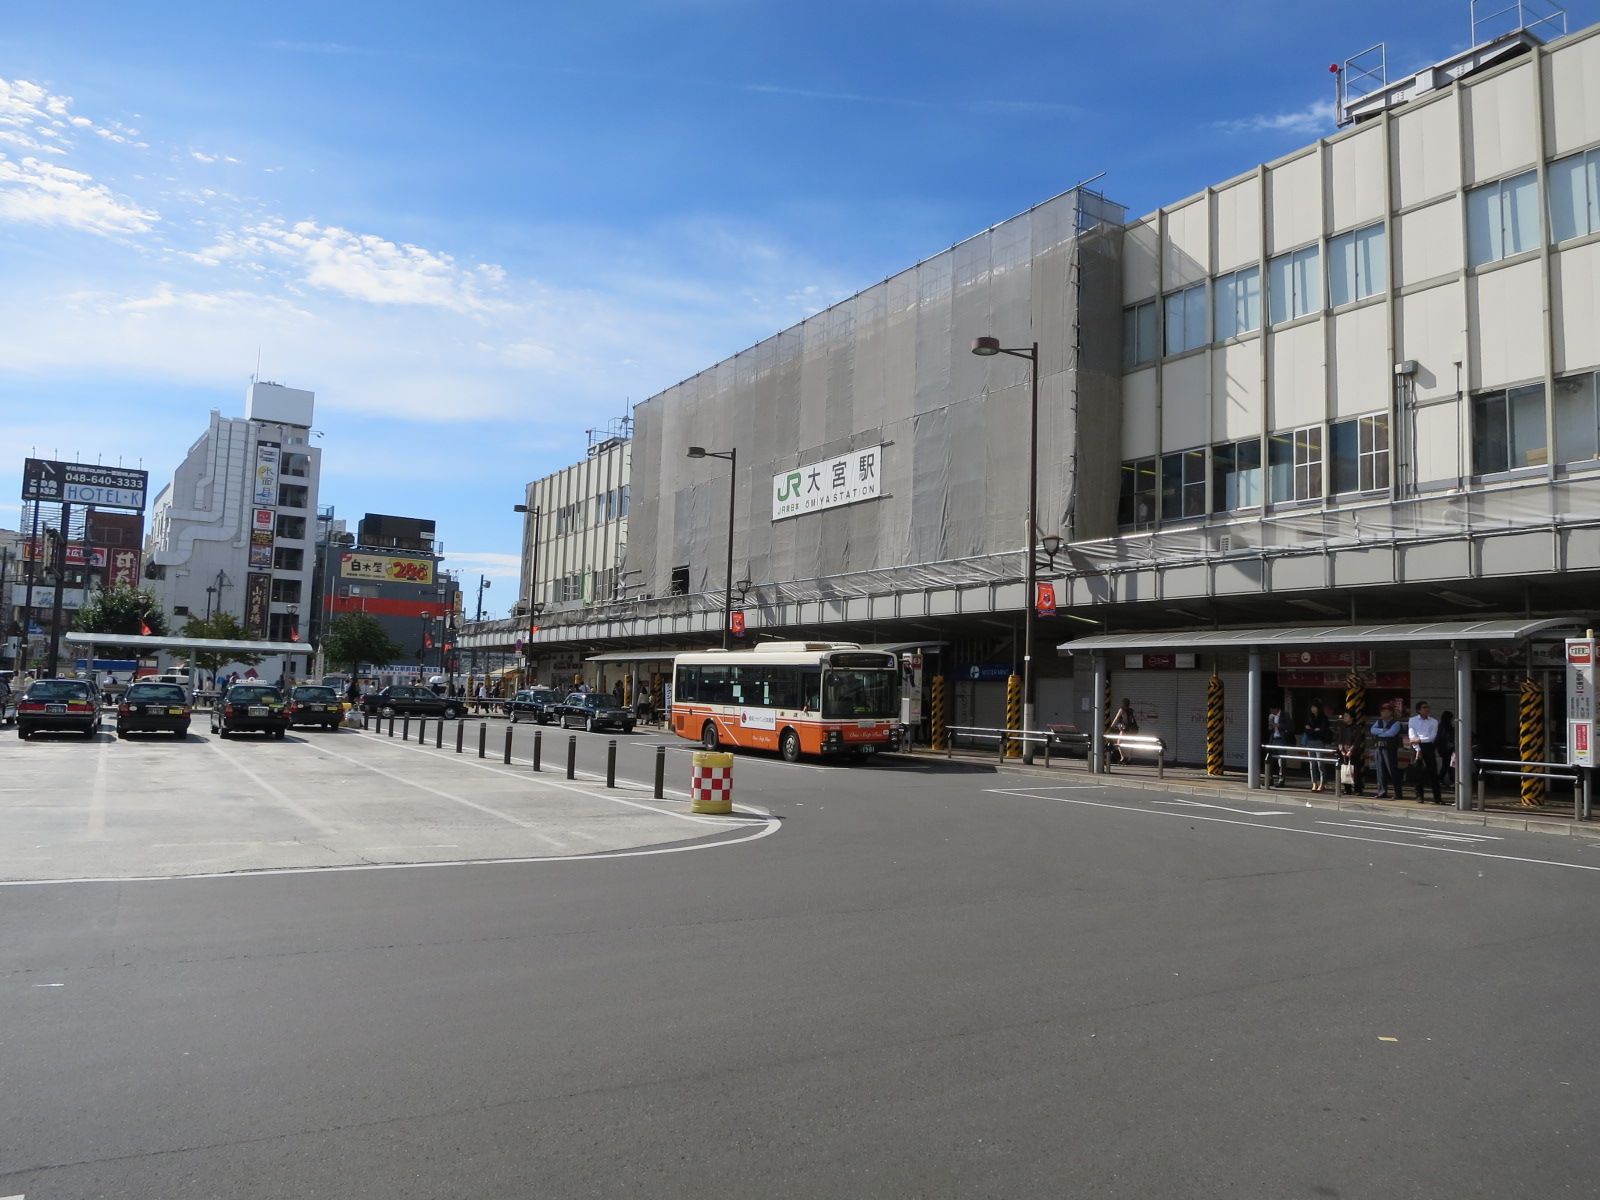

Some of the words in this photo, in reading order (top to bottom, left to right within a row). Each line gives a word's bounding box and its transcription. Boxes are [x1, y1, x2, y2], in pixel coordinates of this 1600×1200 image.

[65, 472, 144, 489] 048-640-3333
[777, 471, 802, 502] JR
[807, 453, 875, 494] 大宮駅
[833, 484, 875, 502] STATION
